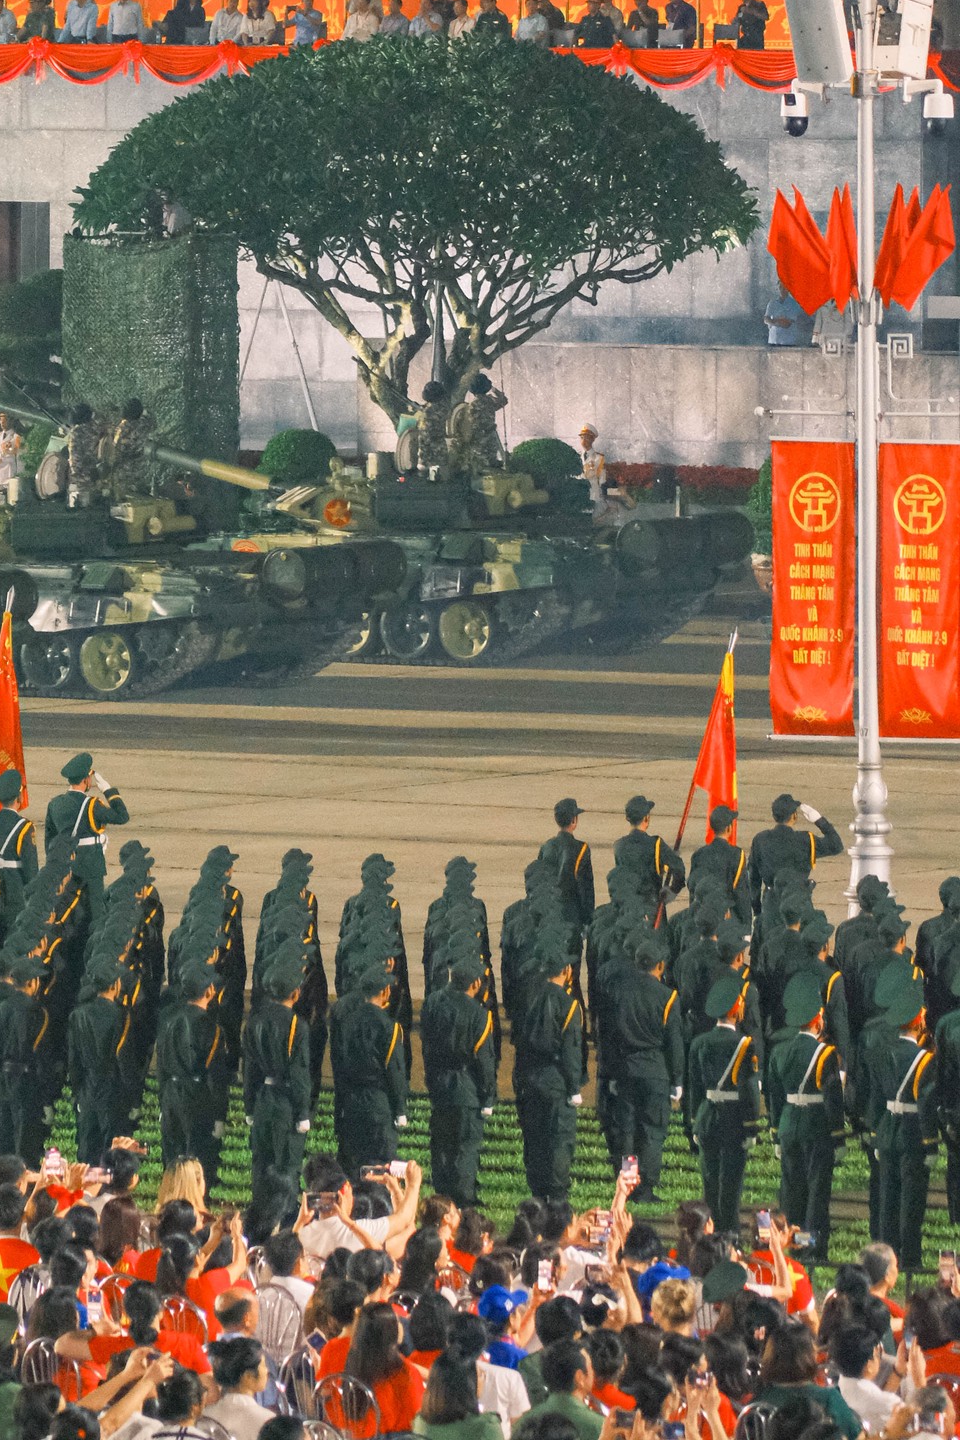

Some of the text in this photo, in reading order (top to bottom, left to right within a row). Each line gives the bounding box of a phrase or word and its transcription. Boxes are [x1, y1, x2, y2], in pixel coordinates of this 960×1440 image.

[793, 543, 810, 558] TINH
[899, 544, 917, 559] TINH
[789, 562, 810, 579] CÁCH
[894, 562, 916, 580] CÁCH
[790, 583, 816, 600] THÁNG
[807, 604, 818, 622] VÀ
[780, 623, 844, 643] QUỐC KHÁNH 2-9
[905, 626, 933, 645] KHÁNH
